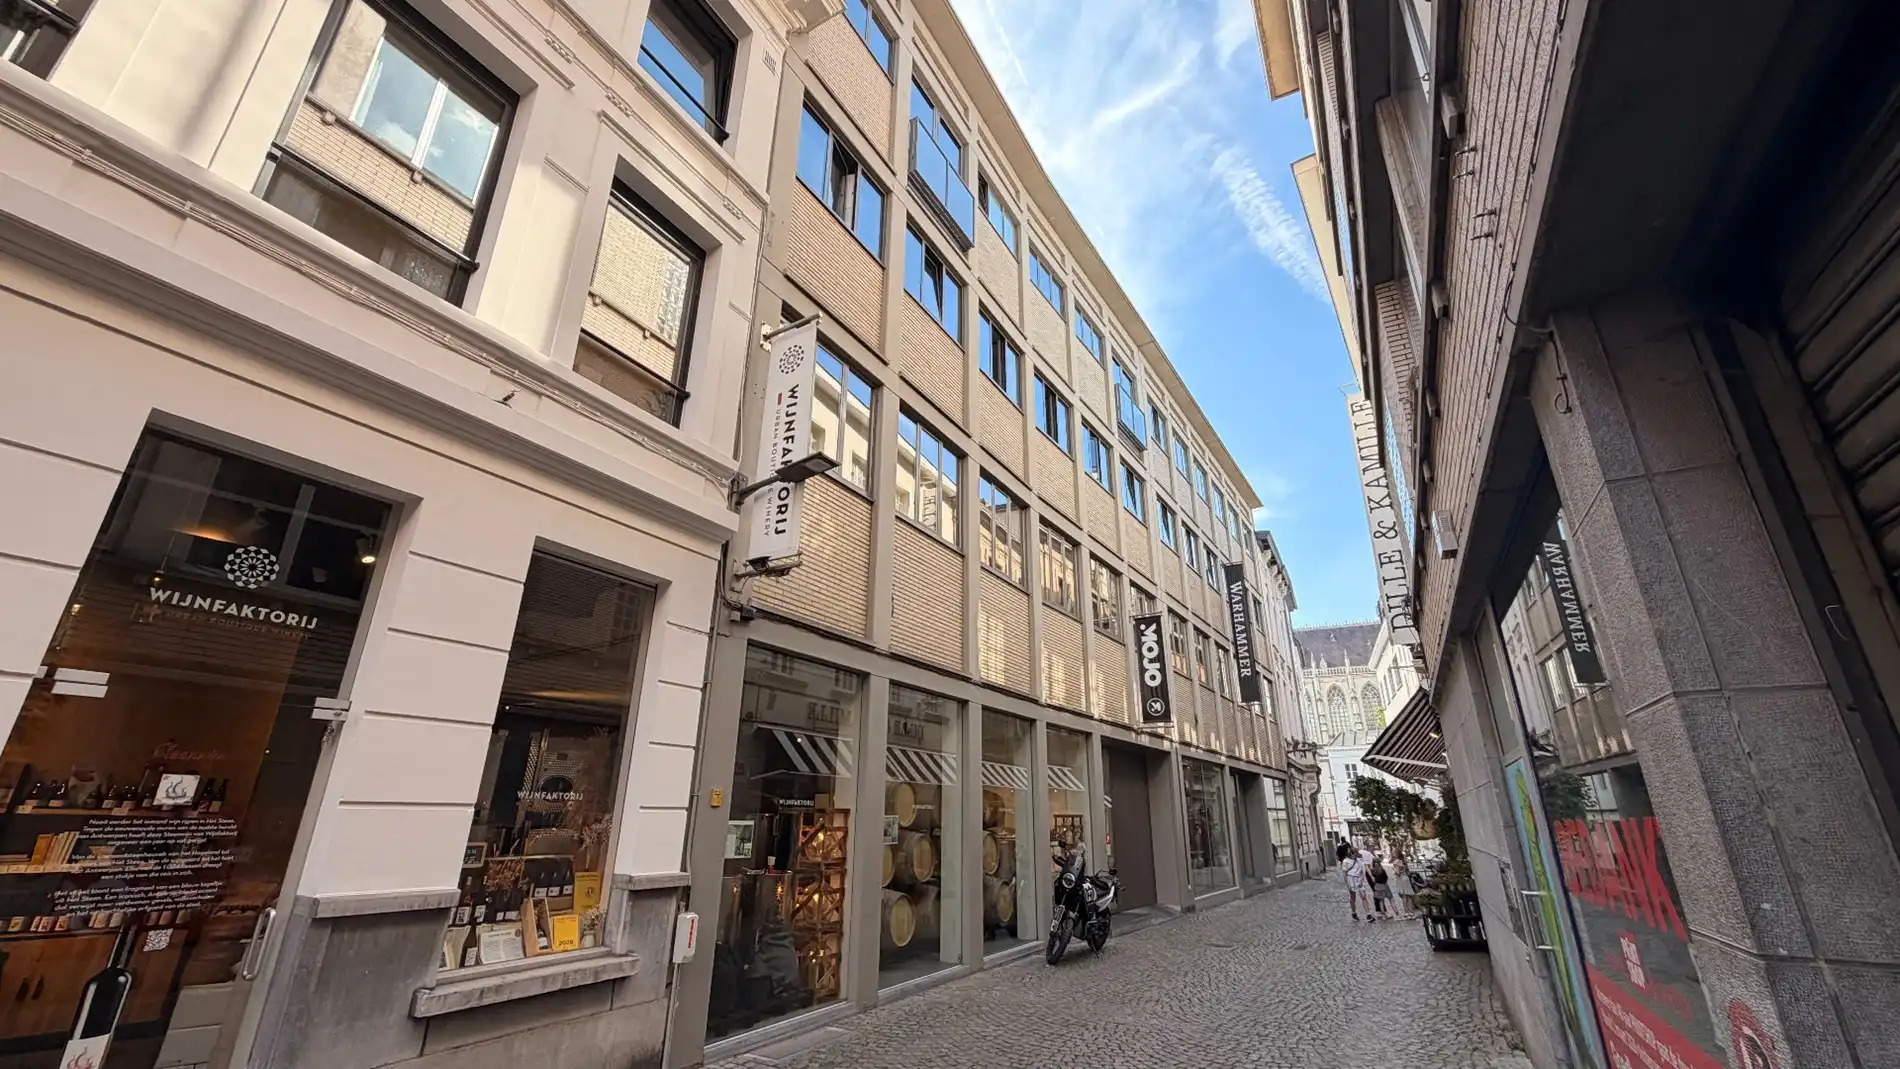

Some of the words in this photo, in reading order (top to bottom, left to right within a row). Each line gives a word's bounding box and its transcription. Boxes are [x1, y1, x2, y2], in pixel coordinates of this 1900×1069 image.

[772, 408, 780, 440] URBAN
[774, 384, 800, 535] WIJNFAORIJ
[1350, 399, 1392, 514] KAMILLE
[764, 496, 772, 536] WINERY
[1374, 520, 1398, 540] &
[150, 587, 318, 630] WIJNFAKTORIJ
[1378, 548, 1416, 633] DILLE
[1140, 622, 1162, 687] MOJO
[1230, 581, 1252, 677] WARHAMMER
[516, 790, 584, 801] WIJNFAKTORIJ
